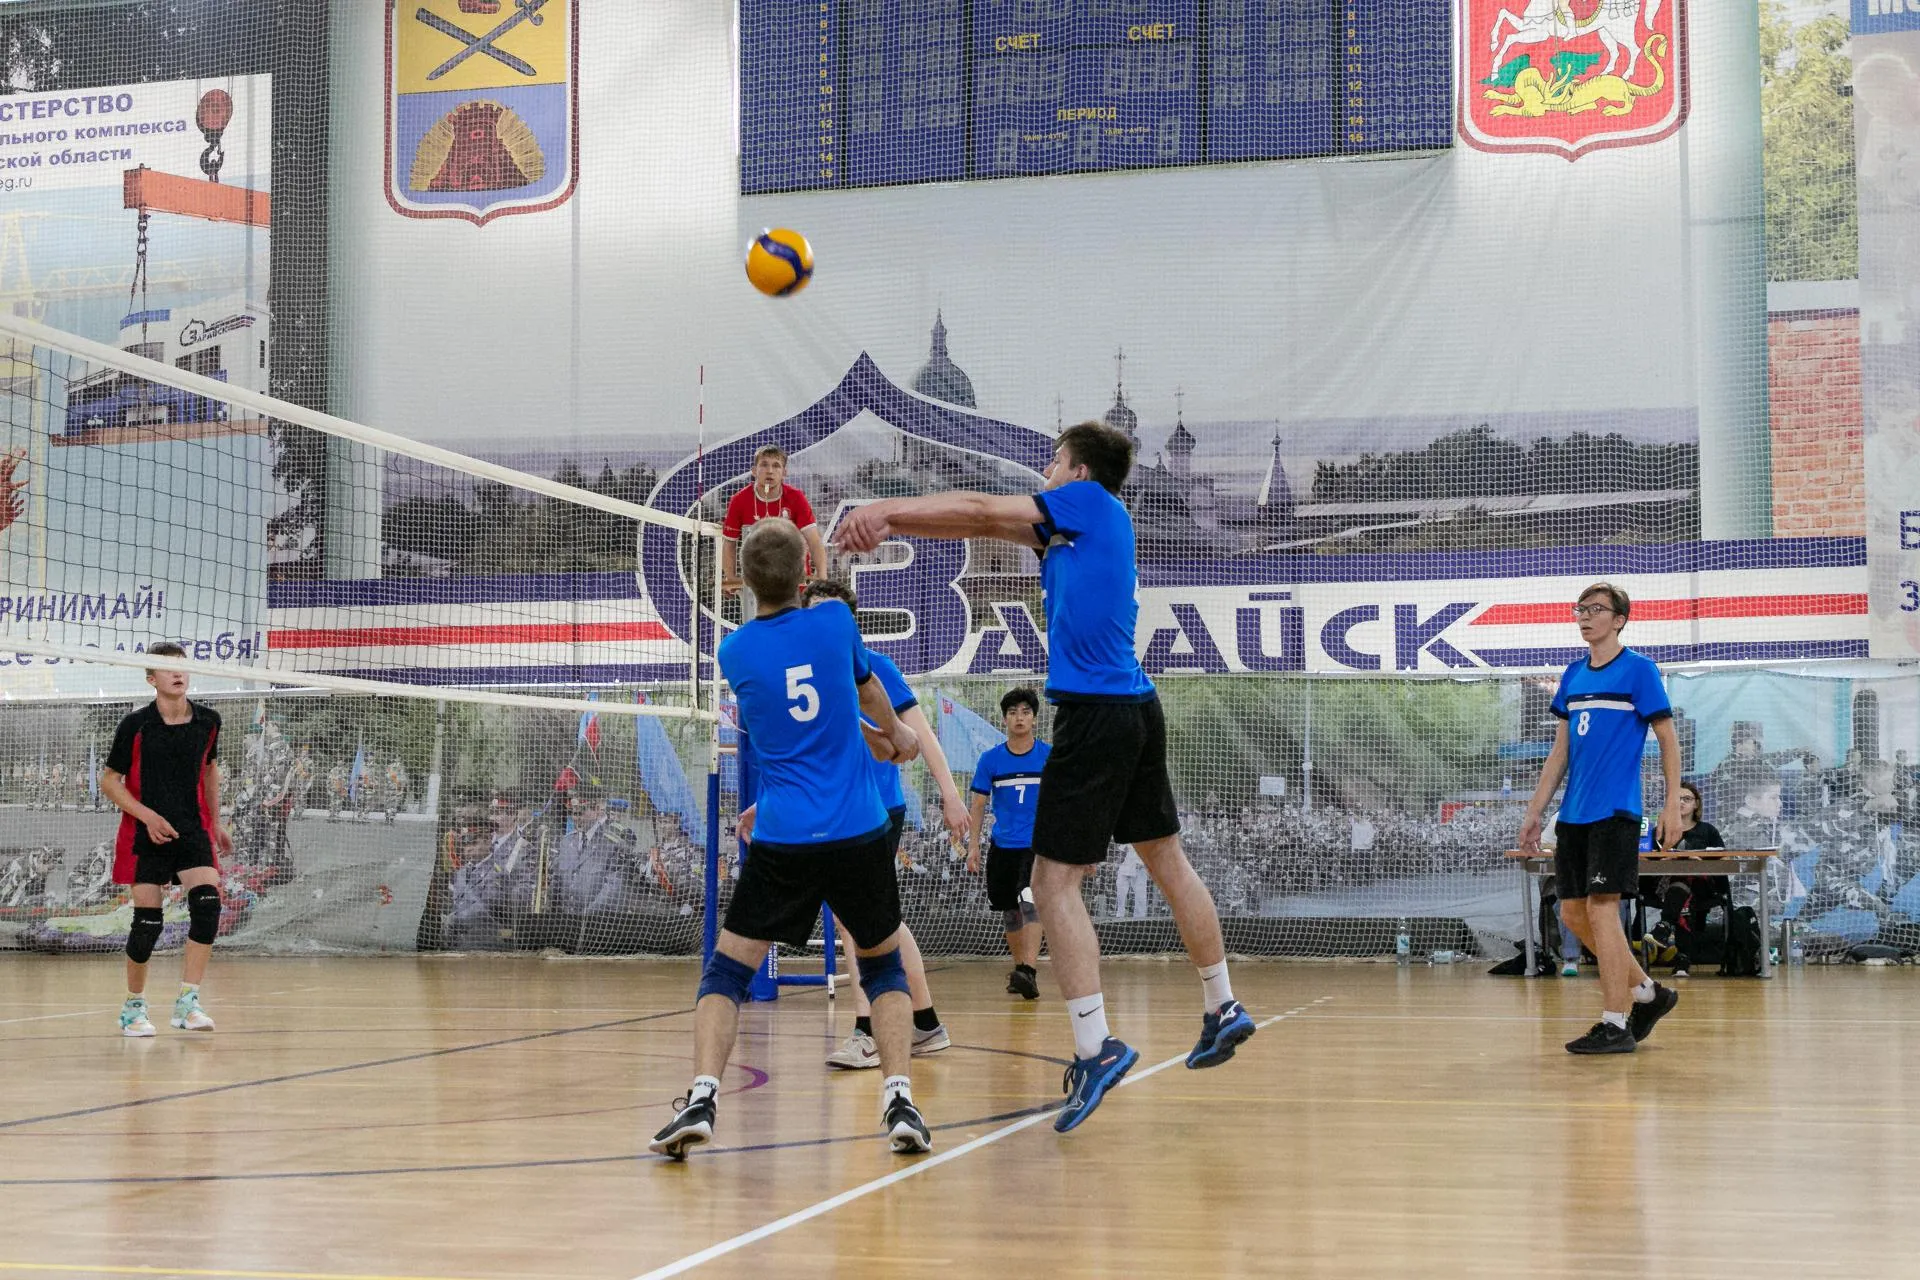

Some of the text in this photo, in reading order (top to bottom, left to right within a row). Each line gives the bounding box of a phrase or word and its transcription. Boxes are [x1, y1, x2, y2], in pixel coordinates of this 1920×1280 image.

[1348, 45, 1361, 55] 10
[1348, 63, 1361, 73] 11
[1348, 81, 1362, 90] 12
[0, 93, 134, 122] СТЕРСТВО
[820, 103, 832, 112] 11
[1349, 98, 1362, 107] 13
[1057, 106, 1117, 121] ПЕРИОД
[75, 119, 188, 140] комплекса
[820, 119, 833, 129] 12
[820, 136, 833, 145] 13
[49, 147, 132, 166] области
[786, 664, 820, 722] 5
[1577, 711, 1590, 736] 8
[1015, 785, 1026, 804] 7
